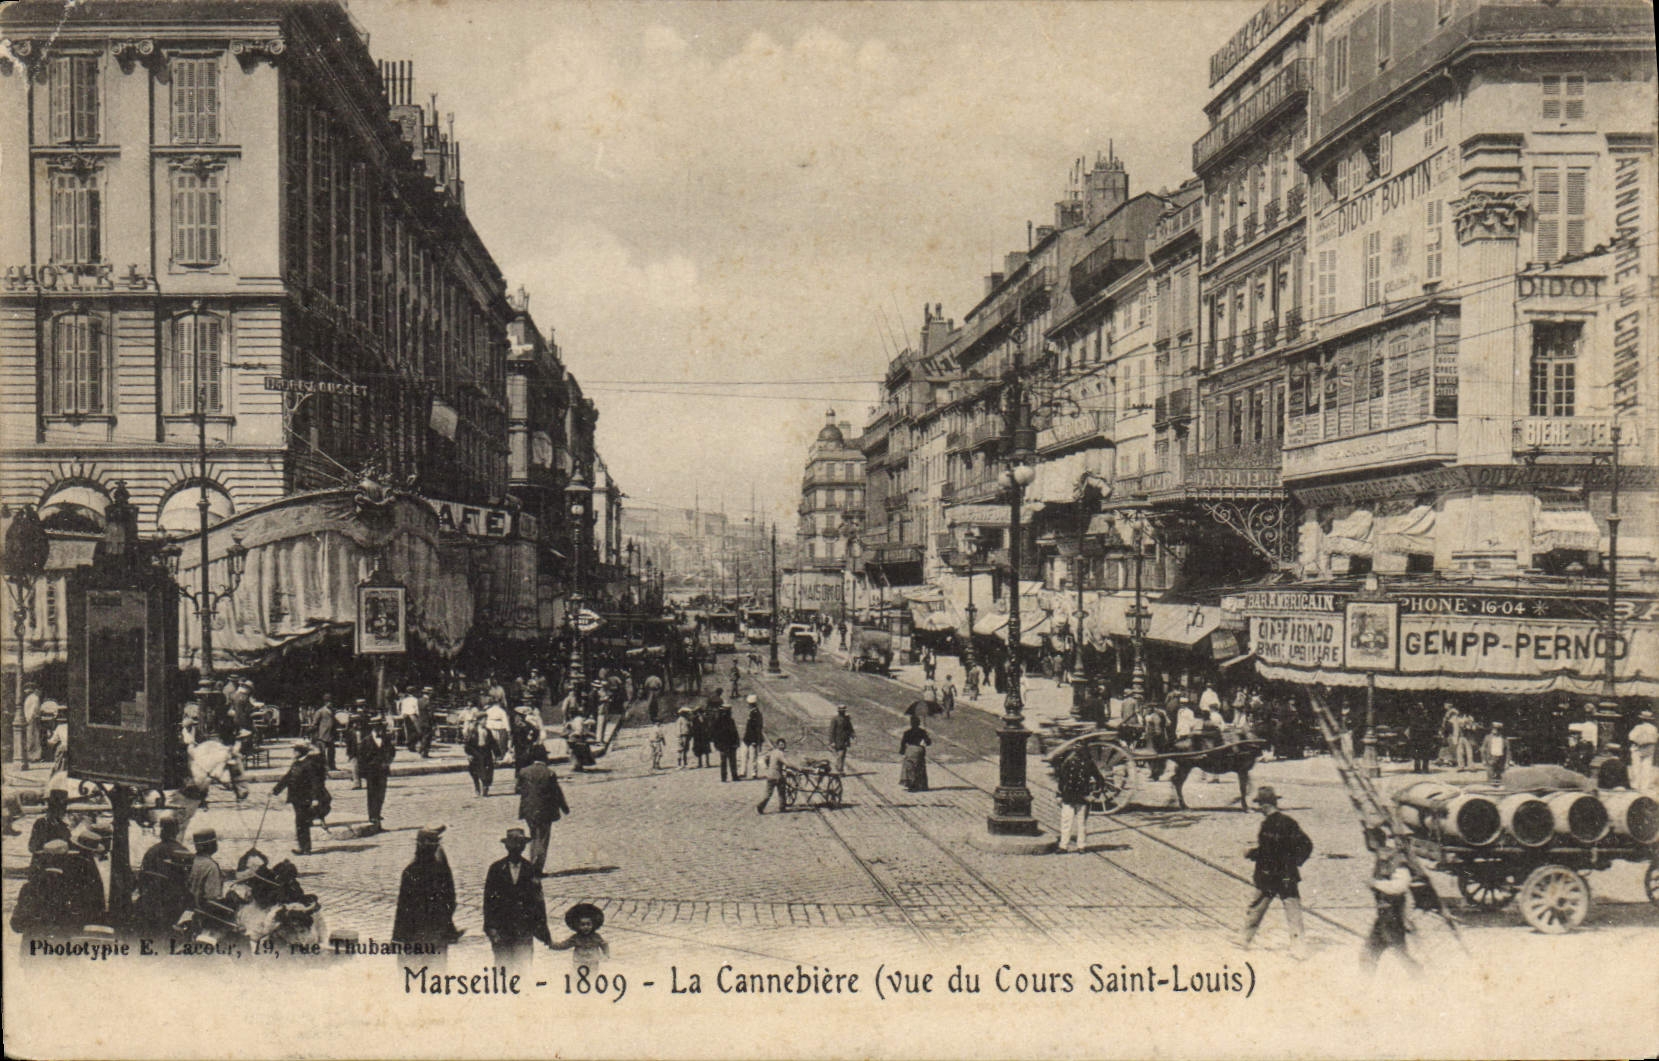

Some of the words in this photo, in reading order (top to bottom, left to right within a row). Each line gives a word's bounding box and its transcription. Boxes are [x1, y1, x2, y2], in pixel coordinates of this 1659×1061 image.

[1518, 275, 1603, 298] DIDOT
[1613, 310, 1641, 416] COMMER
[428, 502, 507, 535] AFE
[1405, 630, 1629, 661] GEMPP-PERNOD
